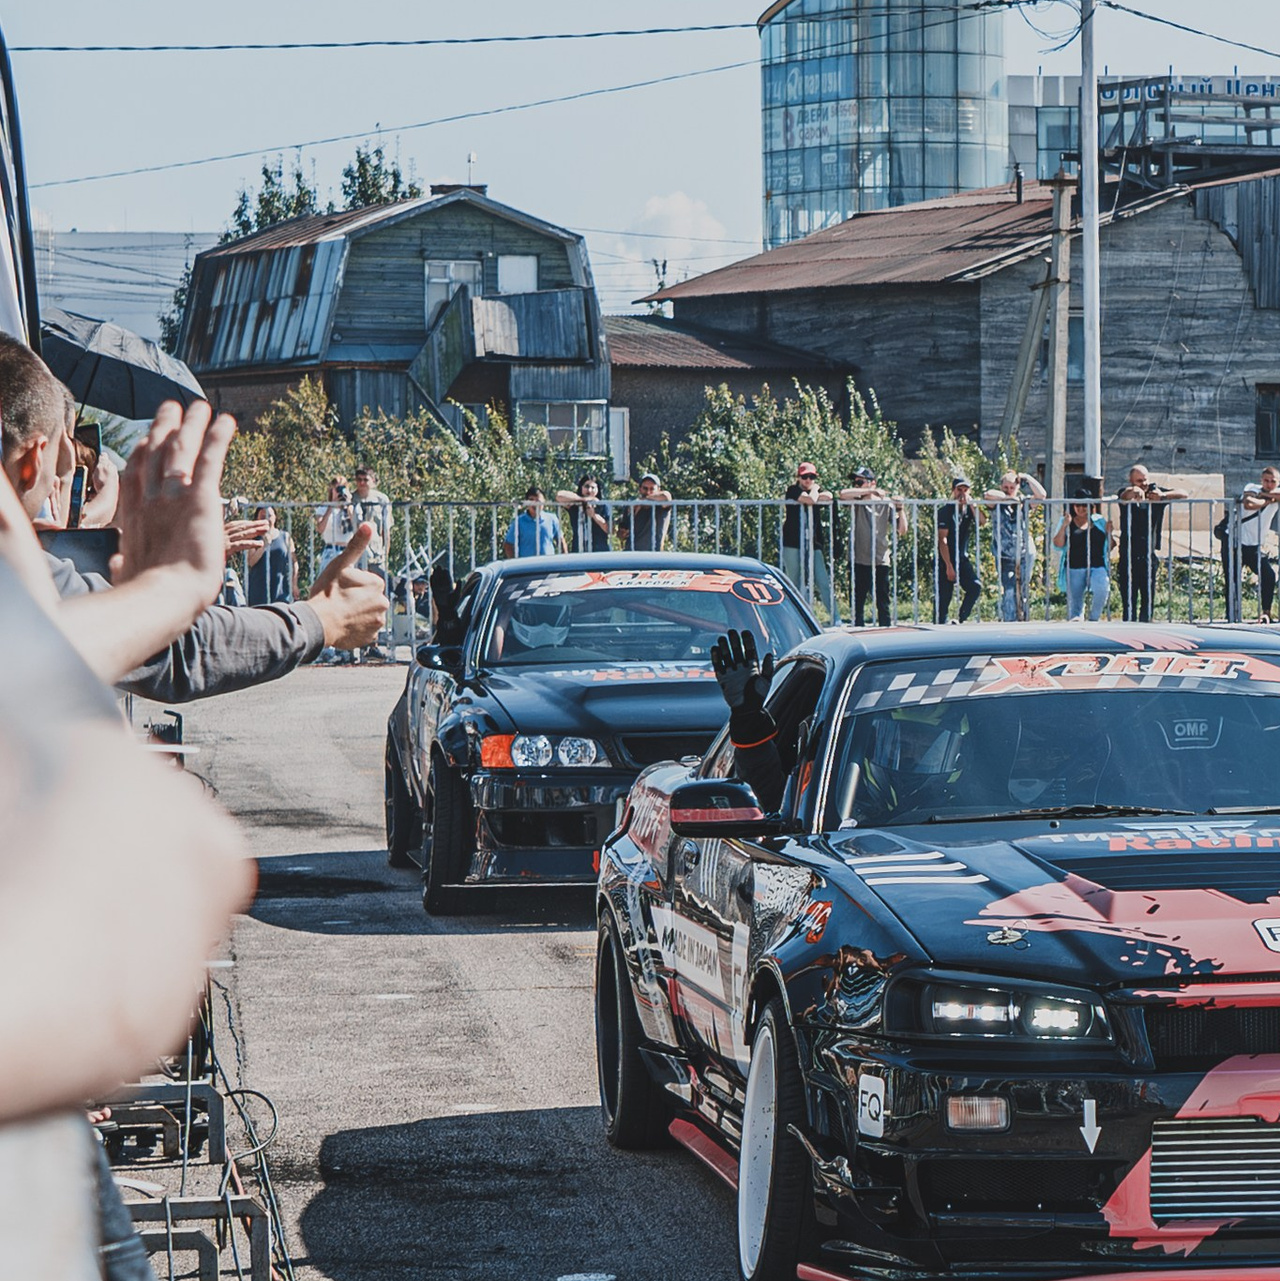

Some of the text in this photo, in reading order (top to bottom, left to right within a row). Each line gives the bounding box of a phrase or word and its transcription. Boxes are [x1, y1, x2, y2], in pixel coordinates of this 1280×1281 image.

[741, 582, 773, 601] 11
[1174, 721, 1209, 737] OMP
[695, 941, 719, 979] JAPAN
[860, 1090, 881, 1122] FQ
